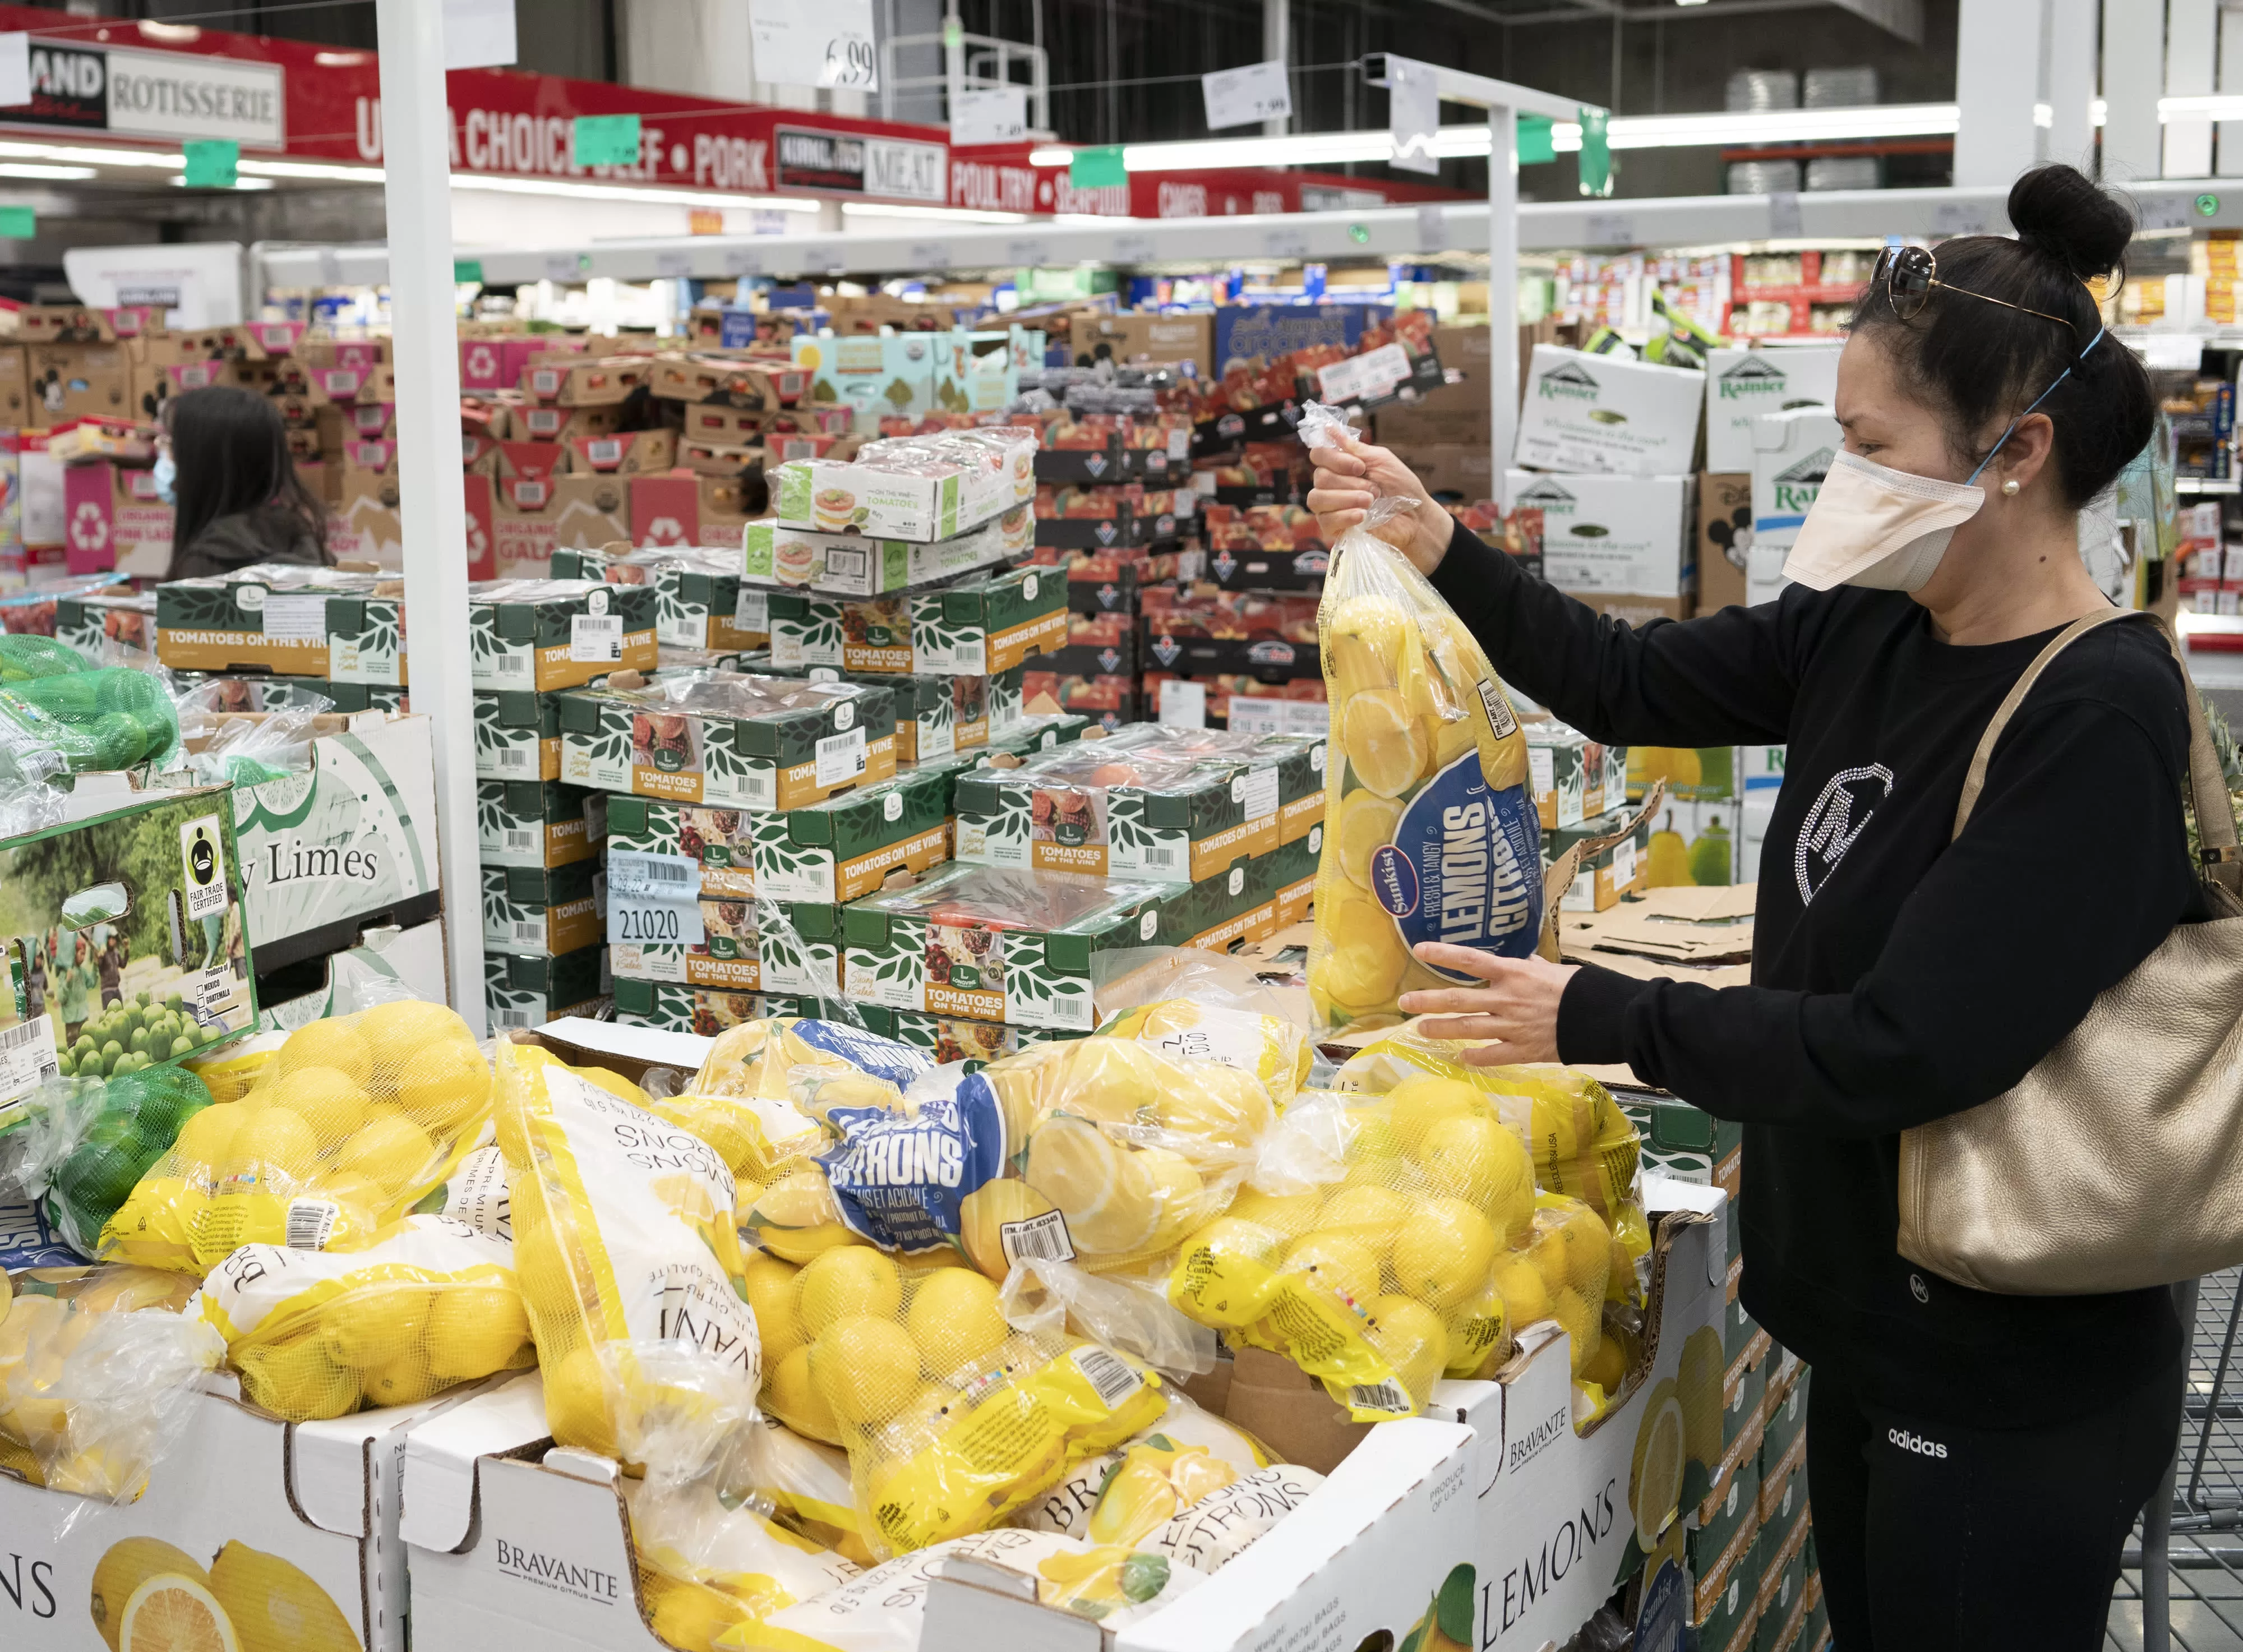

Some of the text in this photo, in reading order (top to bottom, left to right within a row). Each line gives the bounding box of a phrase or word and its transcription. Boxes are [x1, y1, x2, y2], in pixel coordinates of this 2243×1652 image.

[114, 74, 274, 123] ROTISSERIE
[694, 133, 768, 190] PORK
[871, 147, 939, 194] MEAT
[952, 161, 1037, 210] POULTRY
[866, 496, 919, 509] TOMATOES
[168, 631, 243, 645] TOMATOES
[247, 634, 267, 645] ON
[993, 629, 1029, 651] TOMATOES
[1030, 626, 1037, 638] ON
[1039, 622, 1050, 636] THE
[846, 647, 911, 661] TOMATOES
[872, 737, 893, 754] VINE
[639, 772, 696, 788] TOMATOES
[1284, 797, 1315, 819] TOMATOES
[552, 818, 585, 838] TOMAT
[1199, 813, 1276, 855] TOMATOES ON THE VINE
[268, 840, 378, 883] Limes
[844, 832, 943, 879] TOMATOES ON THE VINE
[1039, 846, 1101, 860] TOMATOES
[1385, 849, 1409, 916] Sunkist
[1424, 841, 1442, 919] FRESH & TANGY
[1441, 802, 1489, 943] LEMONS
[190, 883, 224, 902] FAIR TRADE
[1279, 883, 1312, 906] TOMATOES
[556, 898, 595, 919] TOMATO
[619, 909, 679, 940] 21020
[1196, 906, 1272, 950] TOMATOES ON THE VINE
[205, 963, 229, 979] Produce of
[689, 959, 758, 976] TOMATOES
[695, 970, 708, 979] ON
[961, 967, 969, 979] L
[204, 979, 220, 992] MEXICO
[952, 977, 977, 986] LONGVINE
[205, 988, 231, 1004] GUATEMALA
[927, 988, 1003, 1009] TOMATOES
[950, 1004, 970, 1012] THE
[972, 1007, 996, 1016] VINE
[1548, 1132, 1558, 1149] USA
[1718, 1151, 1741, 1185] TOMATO
[875, 1188, 888, 1208] ET
[891, 1211, 919, 1225] PRODUIT
[1003, 1225, 1018, 1238] ITM.
[1510, 1406, 1566, 1467] BRAVANTE
[1888, 1427, 1948, 1459] adidas
[1521, 1438, 1553, 1468] PREMIUM CITRUS
[1429, 1462, 1466, 1501] PRODUCE
[1432, 1482, 1466, 1513] OF U.S.A.
[496, 1538, 618, 1600] BRAVANTE
[1480, 1478, 1616, 1652] LEMONS
[1699, 1557, 1729, 1599] TOMATOES
[523, 1574, 589, 1600] PREMIUM CITRUS
[1285, 1620, 1314, 1652] (907g)
[1314, 1596, 1340, 1625] BAGS
[1322, 1610, 1346, 1640] BAGS
